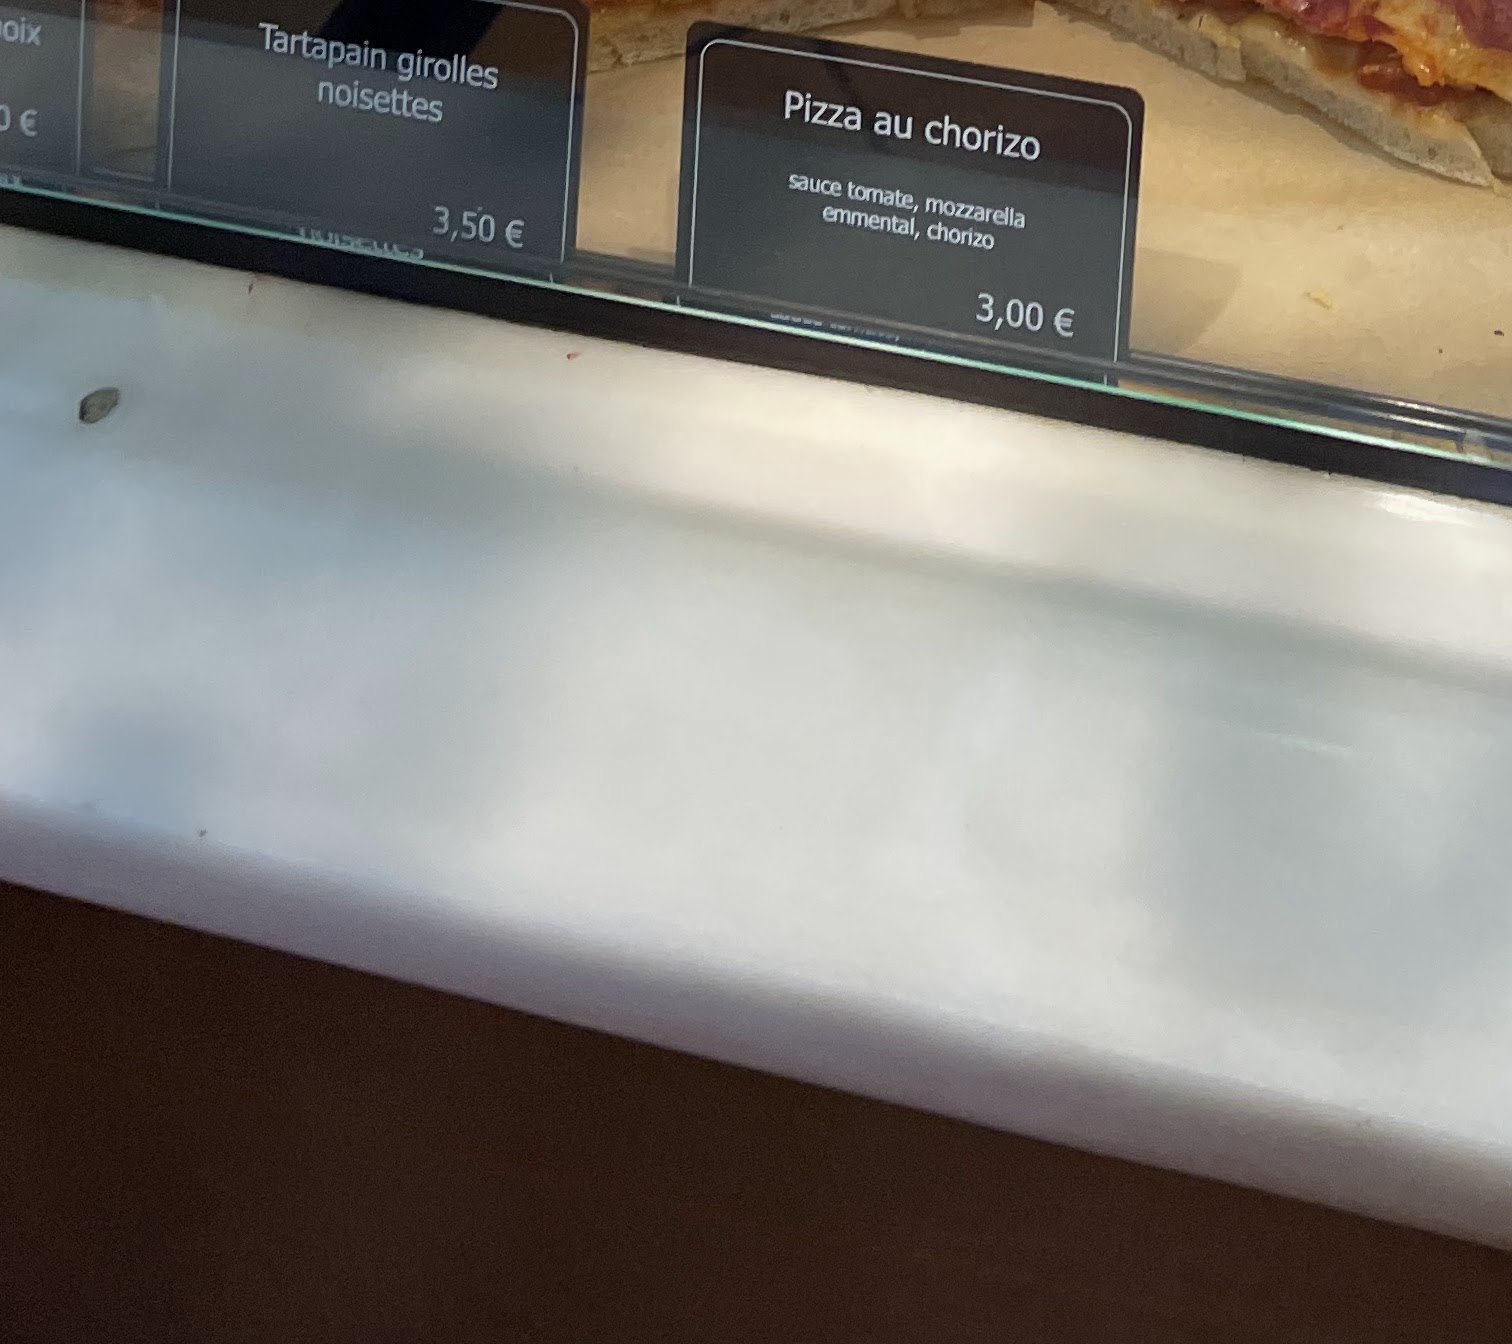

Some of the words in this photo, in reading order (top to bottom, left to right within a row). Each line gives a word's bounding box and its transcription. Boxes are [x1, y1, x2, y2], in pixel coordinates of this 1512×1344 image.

[0, 16, 42, 46] oix
[258, 22, 387, 70] Tartapain
[397, 49, 499, 89] girolles
[20, 109, 38, 137] €
[318, 80, 443, 123] noisettes
[783, 89, 862, 131] Pizza
[873, 110, 913, 140] au
[924, 115, 1041, 161] chorizo
[788, 173, 842, 197] sauce
[847, 181, 919, 213] tomate,
[925, 196, 1026, 229] mozzarella
[432, 206, 495, 244] 3,50
[505, 219, 525, 248] €
[822, 205, 920, 240] emmental,
[926, 221, 995, 250] chorizo
[975, 292, 1044, 331] 3,00
[1053, 307, 1075, 338] €
